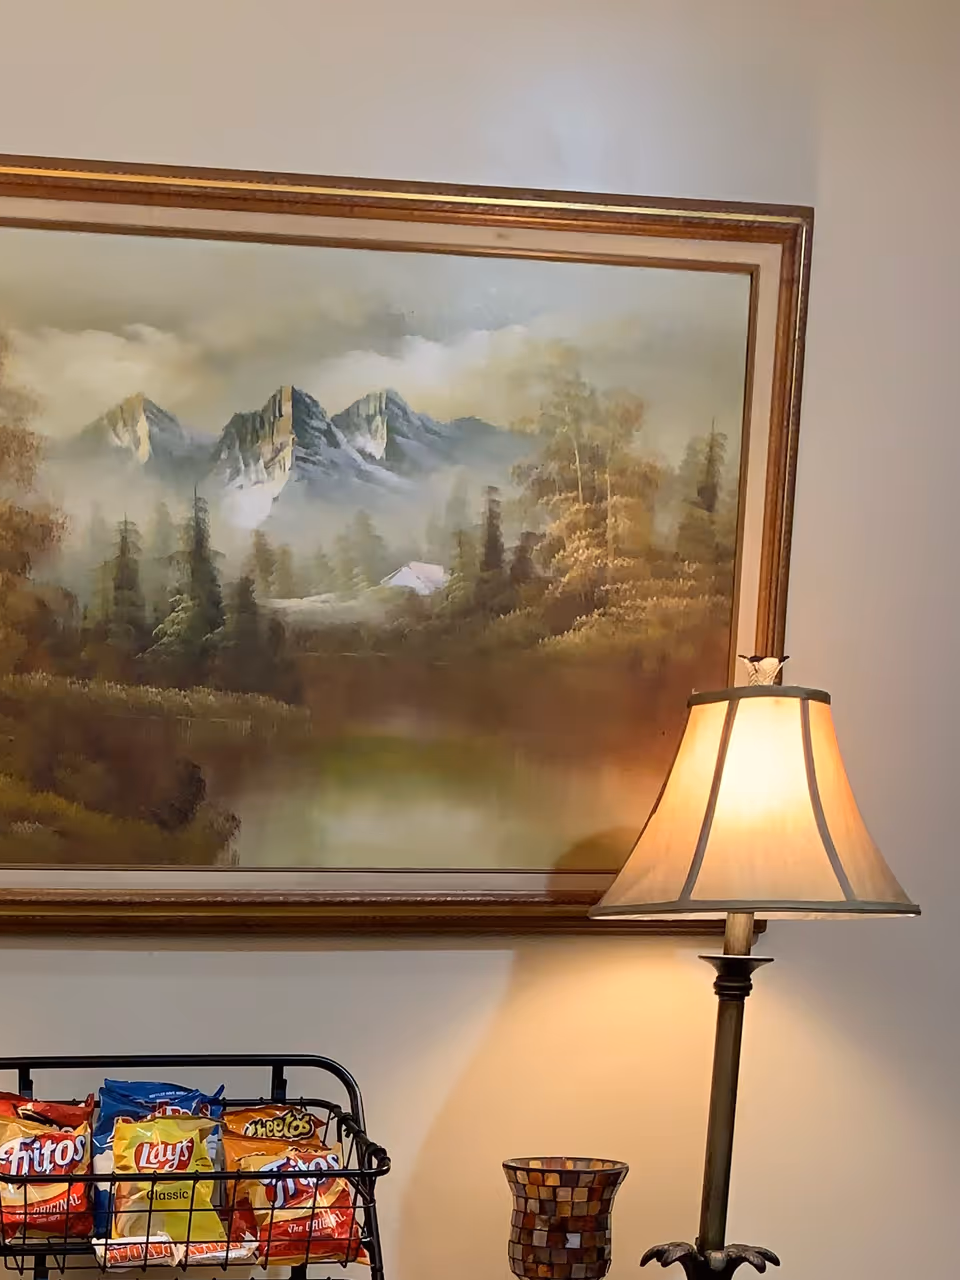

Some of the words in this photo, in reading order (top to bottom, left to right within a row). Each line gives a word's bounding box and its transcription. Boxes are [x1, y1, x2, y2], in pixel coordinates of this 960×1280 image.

[139, 1142, 192, 1171] Lay's
[147, 1189, 189, 1201] Classic
[306, 1211, 346, 1231] ORIGAL
